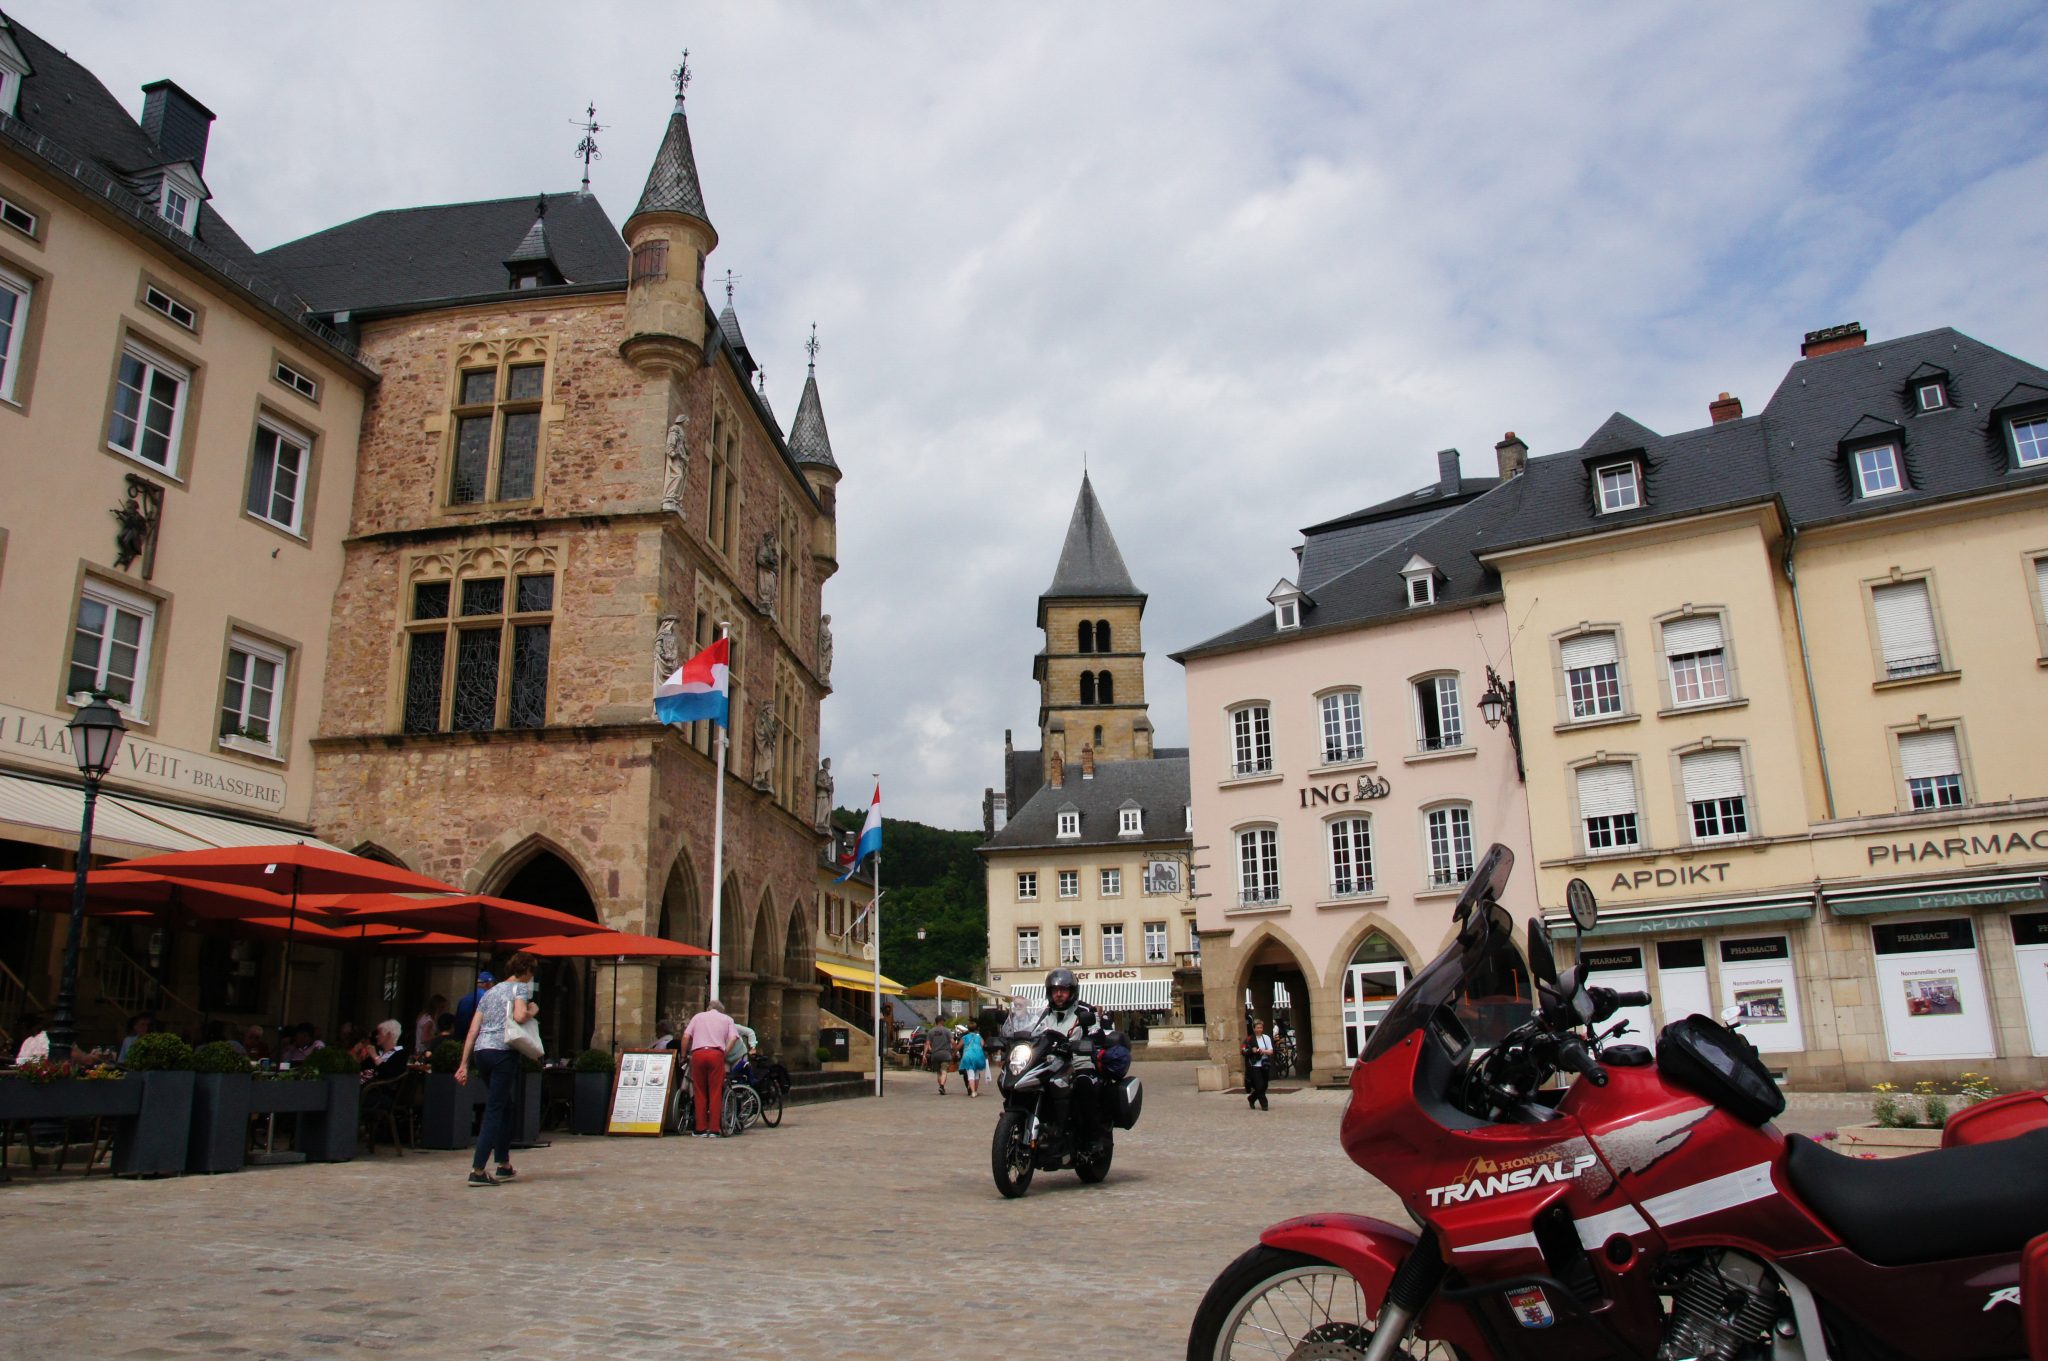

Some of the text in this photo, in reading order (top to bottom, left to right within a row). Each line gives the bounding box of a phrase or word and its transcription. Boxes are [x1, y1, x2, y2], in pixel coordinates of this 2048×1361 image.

[16, 716, 119, 765] LAA
[128, 742, 181, 780] VEIT
[192, 769, 281, 804] BRASSERIE
[1299, 782, 1350, 808] ING
[1867, 829, 2048, 866] PHARMAC
[1611, 862, 1731, 892] APDIKT
[1152, 879, 1177, 892] ING
[1897, 931, 1950, 943] PHARMACIE
[1730, 944, 1778, 955] PHARMACIE
[1589, 955, 1633, 966] PHARMACIE
[1095, 969, 1137, 979] modes
[1938, 967, 1956, 975] Center
[1500, 1152, 1561, 1171] HONDA
[1426, 1154, 1597, 1207] TRANSALP
